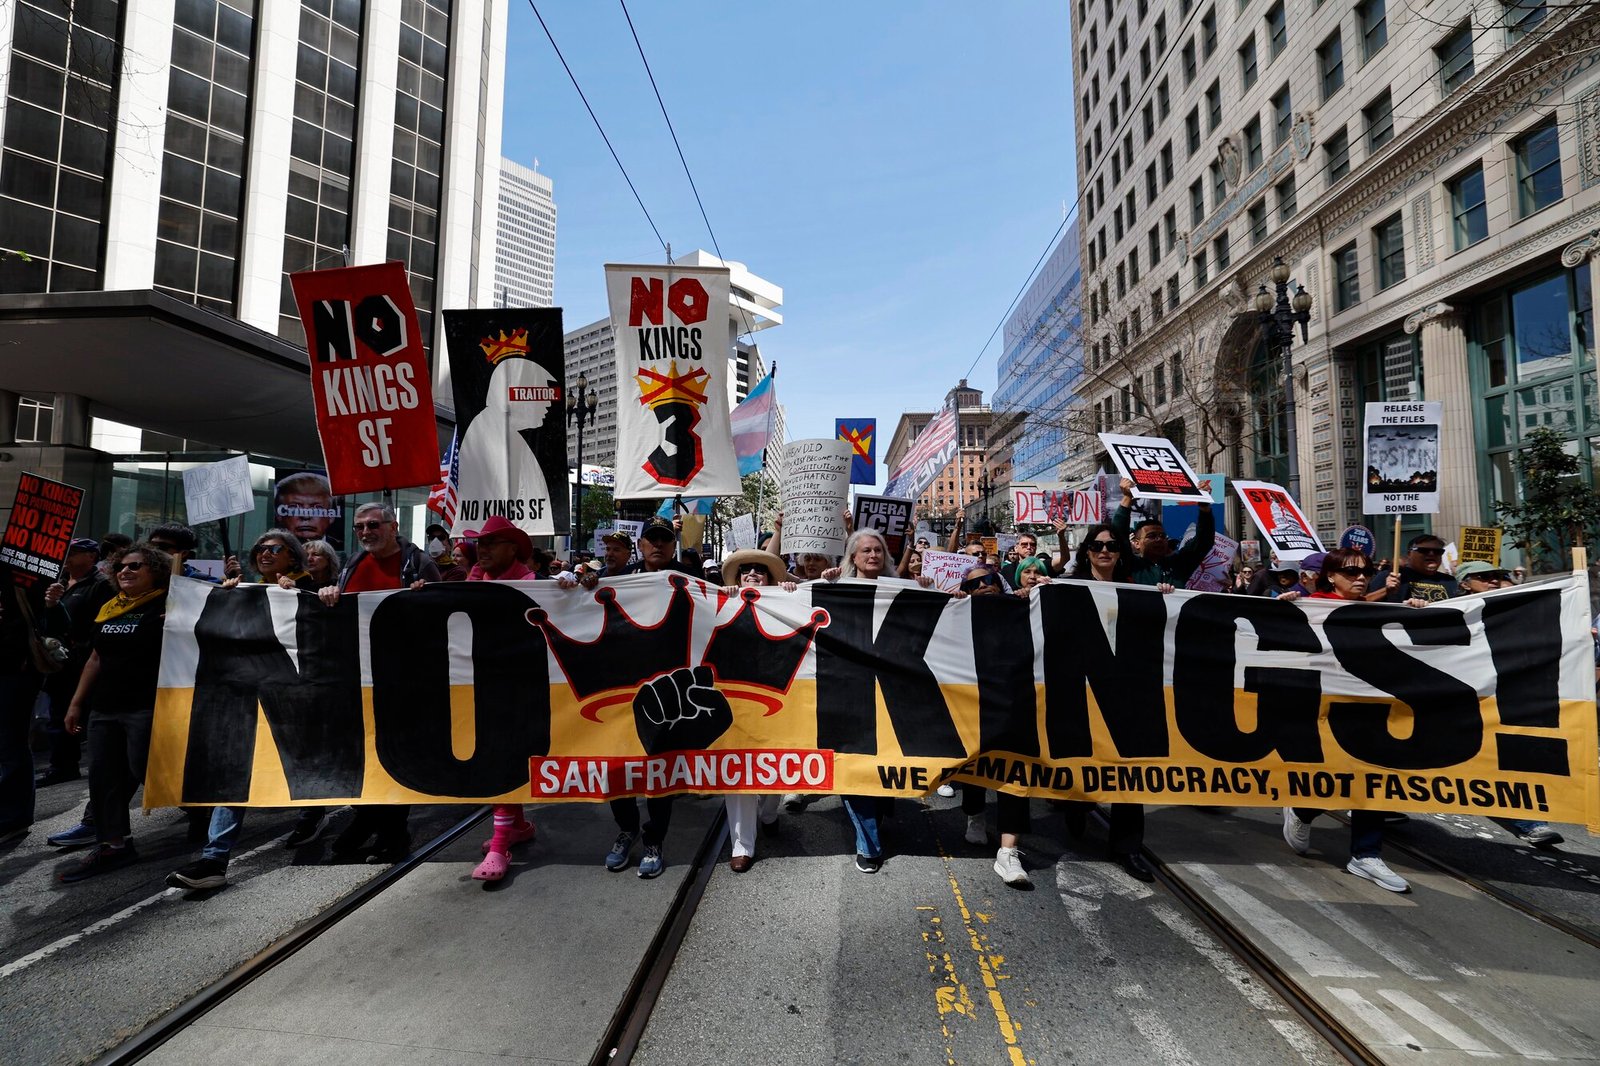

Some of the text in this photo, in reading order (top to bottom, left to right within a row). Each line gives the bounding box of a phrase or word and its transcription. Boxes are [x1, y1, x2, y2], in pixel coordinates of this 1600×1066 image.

[628, 277, 709, 327] NO
[313, 295, 408, 363] NO
[638, 326, 703, 361] KINGS
[322, 362, 419, 417] KINGS
[513, 387, 558, 401] TRAITOR.
[1384, 404, 1425, 412] RELEASE
[358, 418, 393, 468] SF
[641, 402, 705, 488] 3
[803, 443, 823, 455] DID
[1117, 446, 1172, 458] FUERA
[807, 454, 832, 463] BECOME
[834, 454, 849, 463] THE
[1121, 453, 1183, 473] ICE
[803, 473, 837, 481] HATRED
[20, 475, 81, 507] NO KINGS
[277, 504, 341, 518] Criminal
[460, 498, 546, 521] NO KINGS SF
[802, 498, 840, 507] SPILLING
[860, 501, 907, 516] FUERA
[1015, 489, 1100, 523] DEMON
[11, 504, 73, 540] NO ICE
[784, 524, 800, 537] ICE
[857, 512, 906, 536] ICE
[5, 525, 67, 561] NO WAR
[792, 539, 827, 549] KINGS
[1349, 535, 1369, 544] YEARS
[1463, 543, 1495, 552] BILLIONS
[1, 547, 15, 557] RISE
[15, 551, 26, 561] FOR
[27, 555, 39, 565] OUR
[27, 563, 39, 572] OUR
[39, 567, 58, 579] FUTURE
[945, 570, 966, 579] NATIO
[101, 623, 138, 634] RESIST
[183, 580, 1570, 802] NO KINGS!
[539, 752, 827, 795] SAN FRANCISCO
[877, 757, 1549, 812] WE DEMAND DEMOCRACY, NOT FASCISM!
